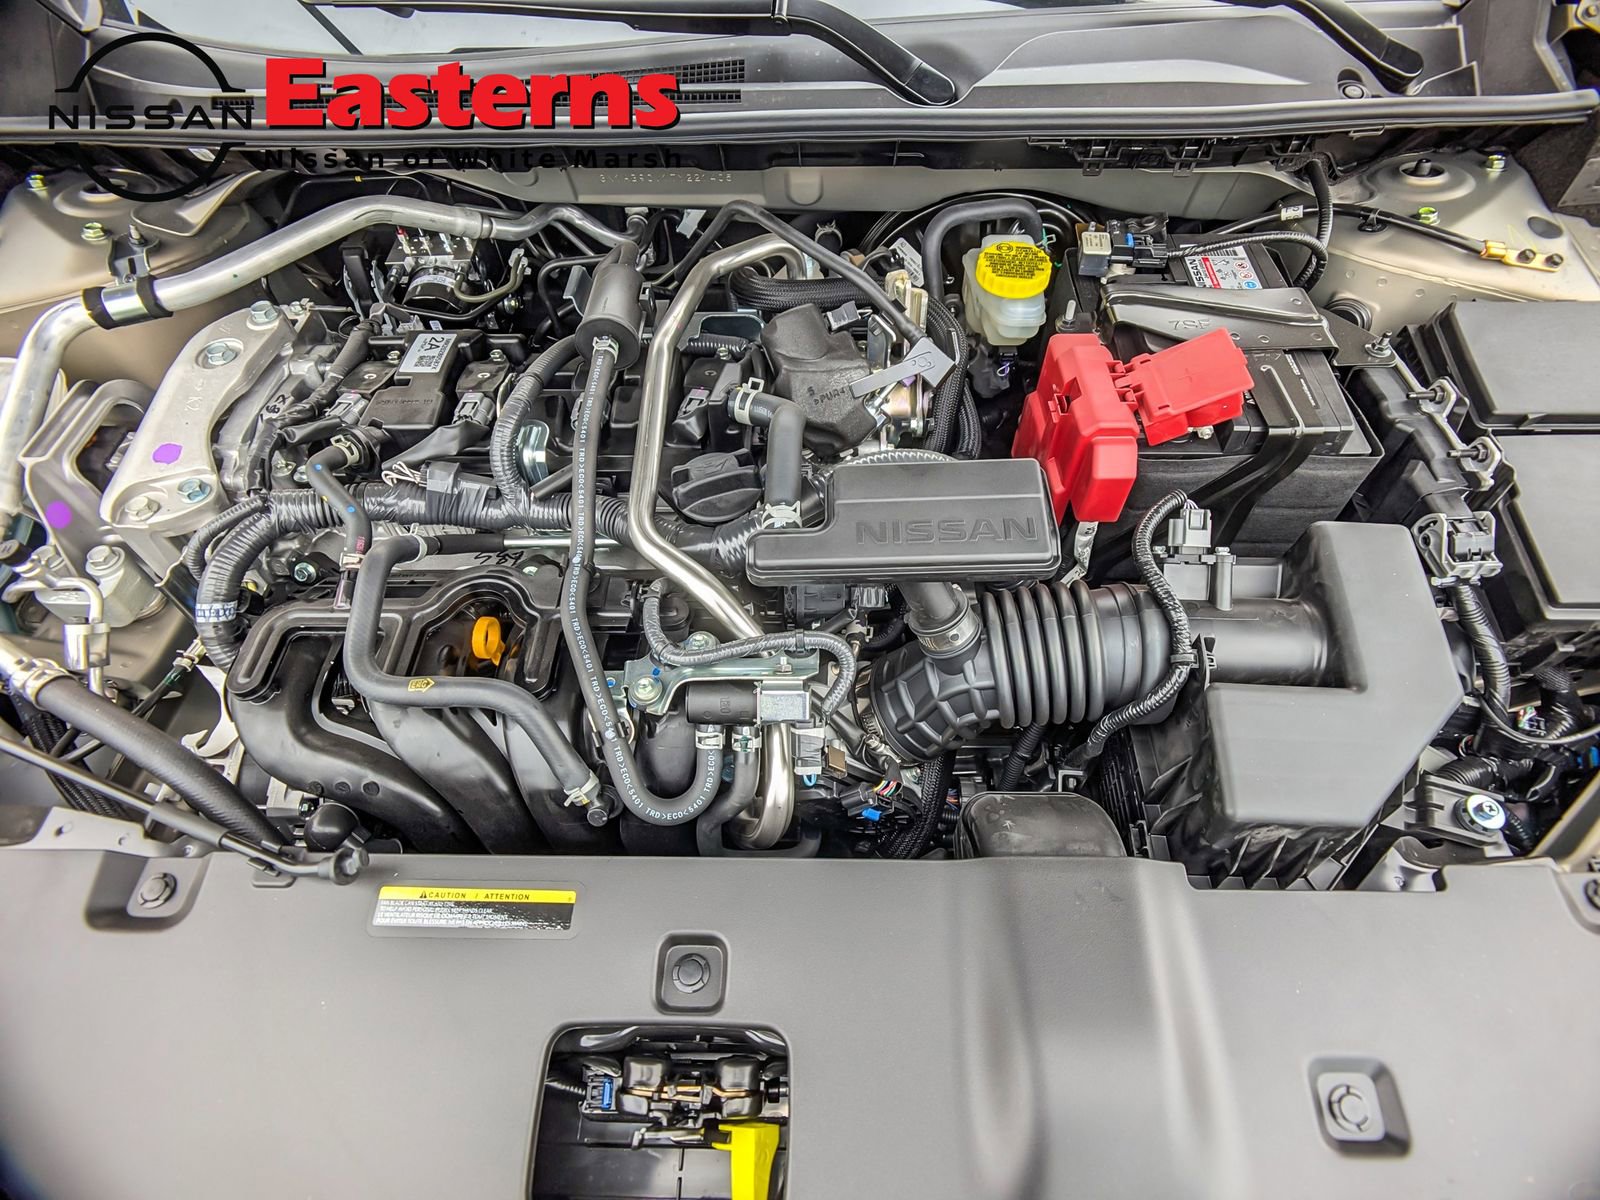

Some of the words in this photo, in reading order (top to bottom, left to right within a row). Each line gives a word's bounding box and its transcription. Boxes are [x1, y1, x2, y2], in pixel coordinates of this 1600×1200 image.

[855, 516, 1038, 545] NISSAN
[428, 891, 467, 899] CAUTION
[484, 892, 531, 900] ATTENTION
